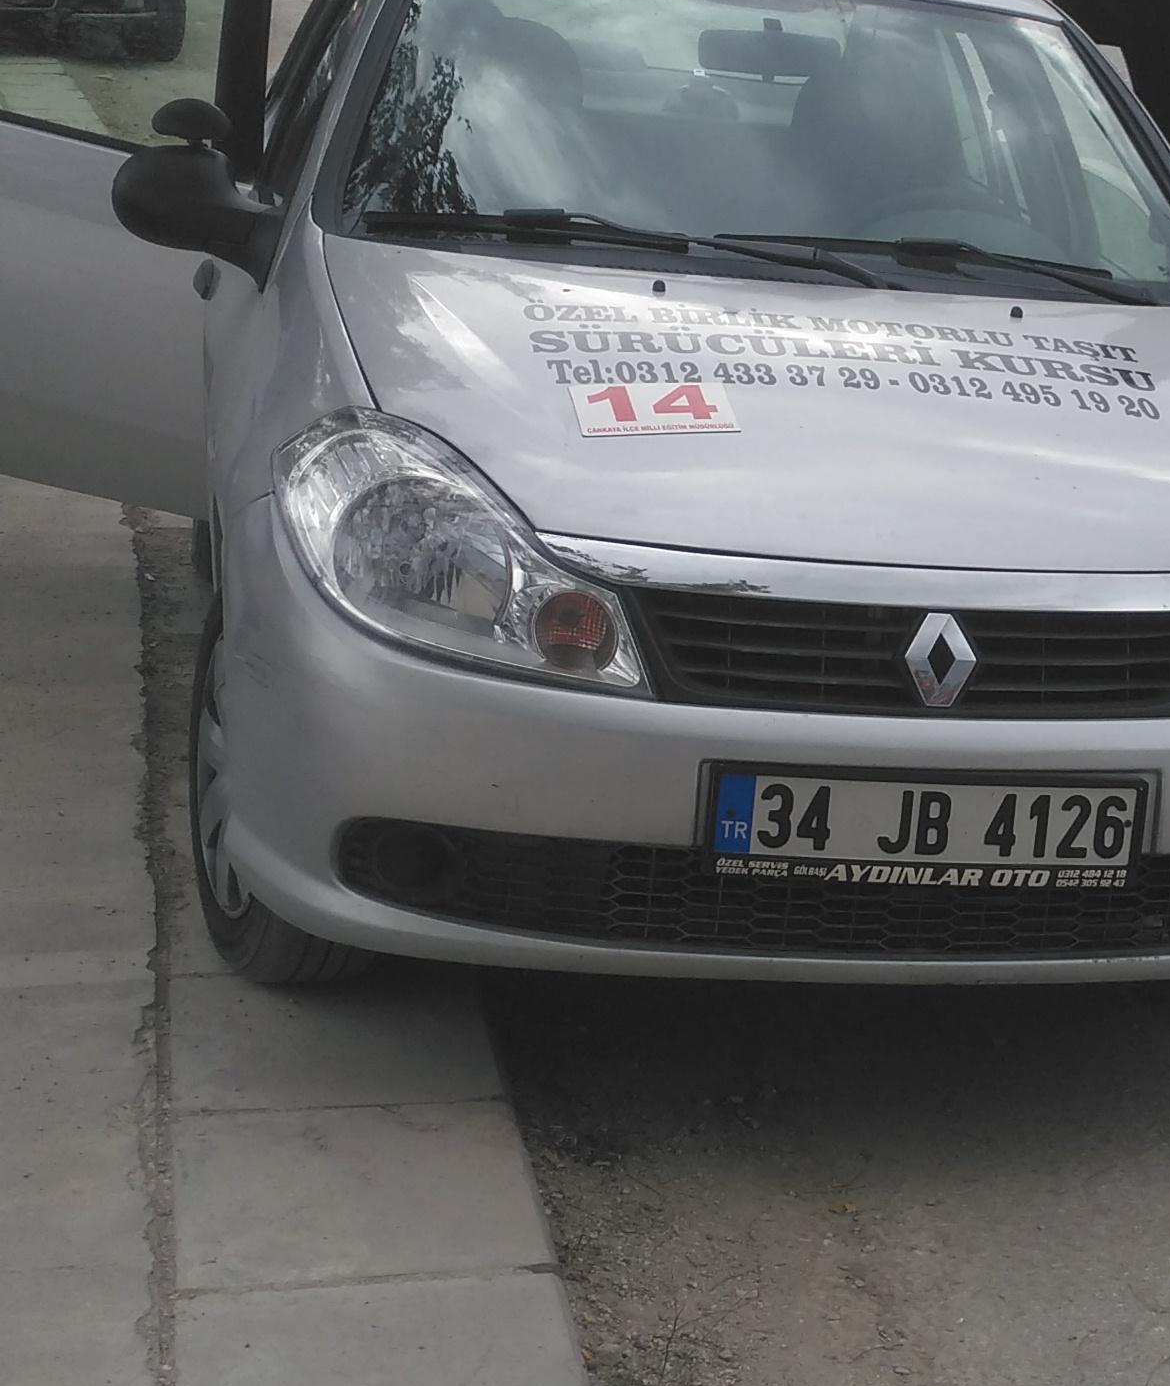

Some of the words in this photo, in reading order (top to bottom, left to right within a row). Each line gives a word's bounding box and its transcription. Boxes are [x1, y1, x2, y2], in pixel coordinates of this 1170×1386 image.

[523, 298, 639, 323] ÖZEL
[648, 304, 802, 330] BİRLİK
[805, 316, 1014, 347] MOTORLU
[1022, 334, 1139, 363] TAŞIT
[529, 324, 942, 367] SÜRÜCÜLERİ
[950, 348, 1157, 392] KURSU
[547, 359, 702, 385] Tel:0312
[714, 363, 777, 386] 433
[786, 365, 826, 387] 37
[838, 366, 881, 390] 29
[908, 370, 993, 400] 0312
[1001, 381, 1062, 408] 495
[1070, 388, 1112, 414] 19
[1118, 394, 1161, 421] 20
[586, 384, 719, 423] 14
[721, 820, 748, 840] TR
[756, 783, 831, 852] 34
[876, 790, 952, 856] JB
[983, 793, 1129, 860] 4126
[824, 863, 982, 887] AYDINLAR
[989, 869, 1050, 887] OTO
